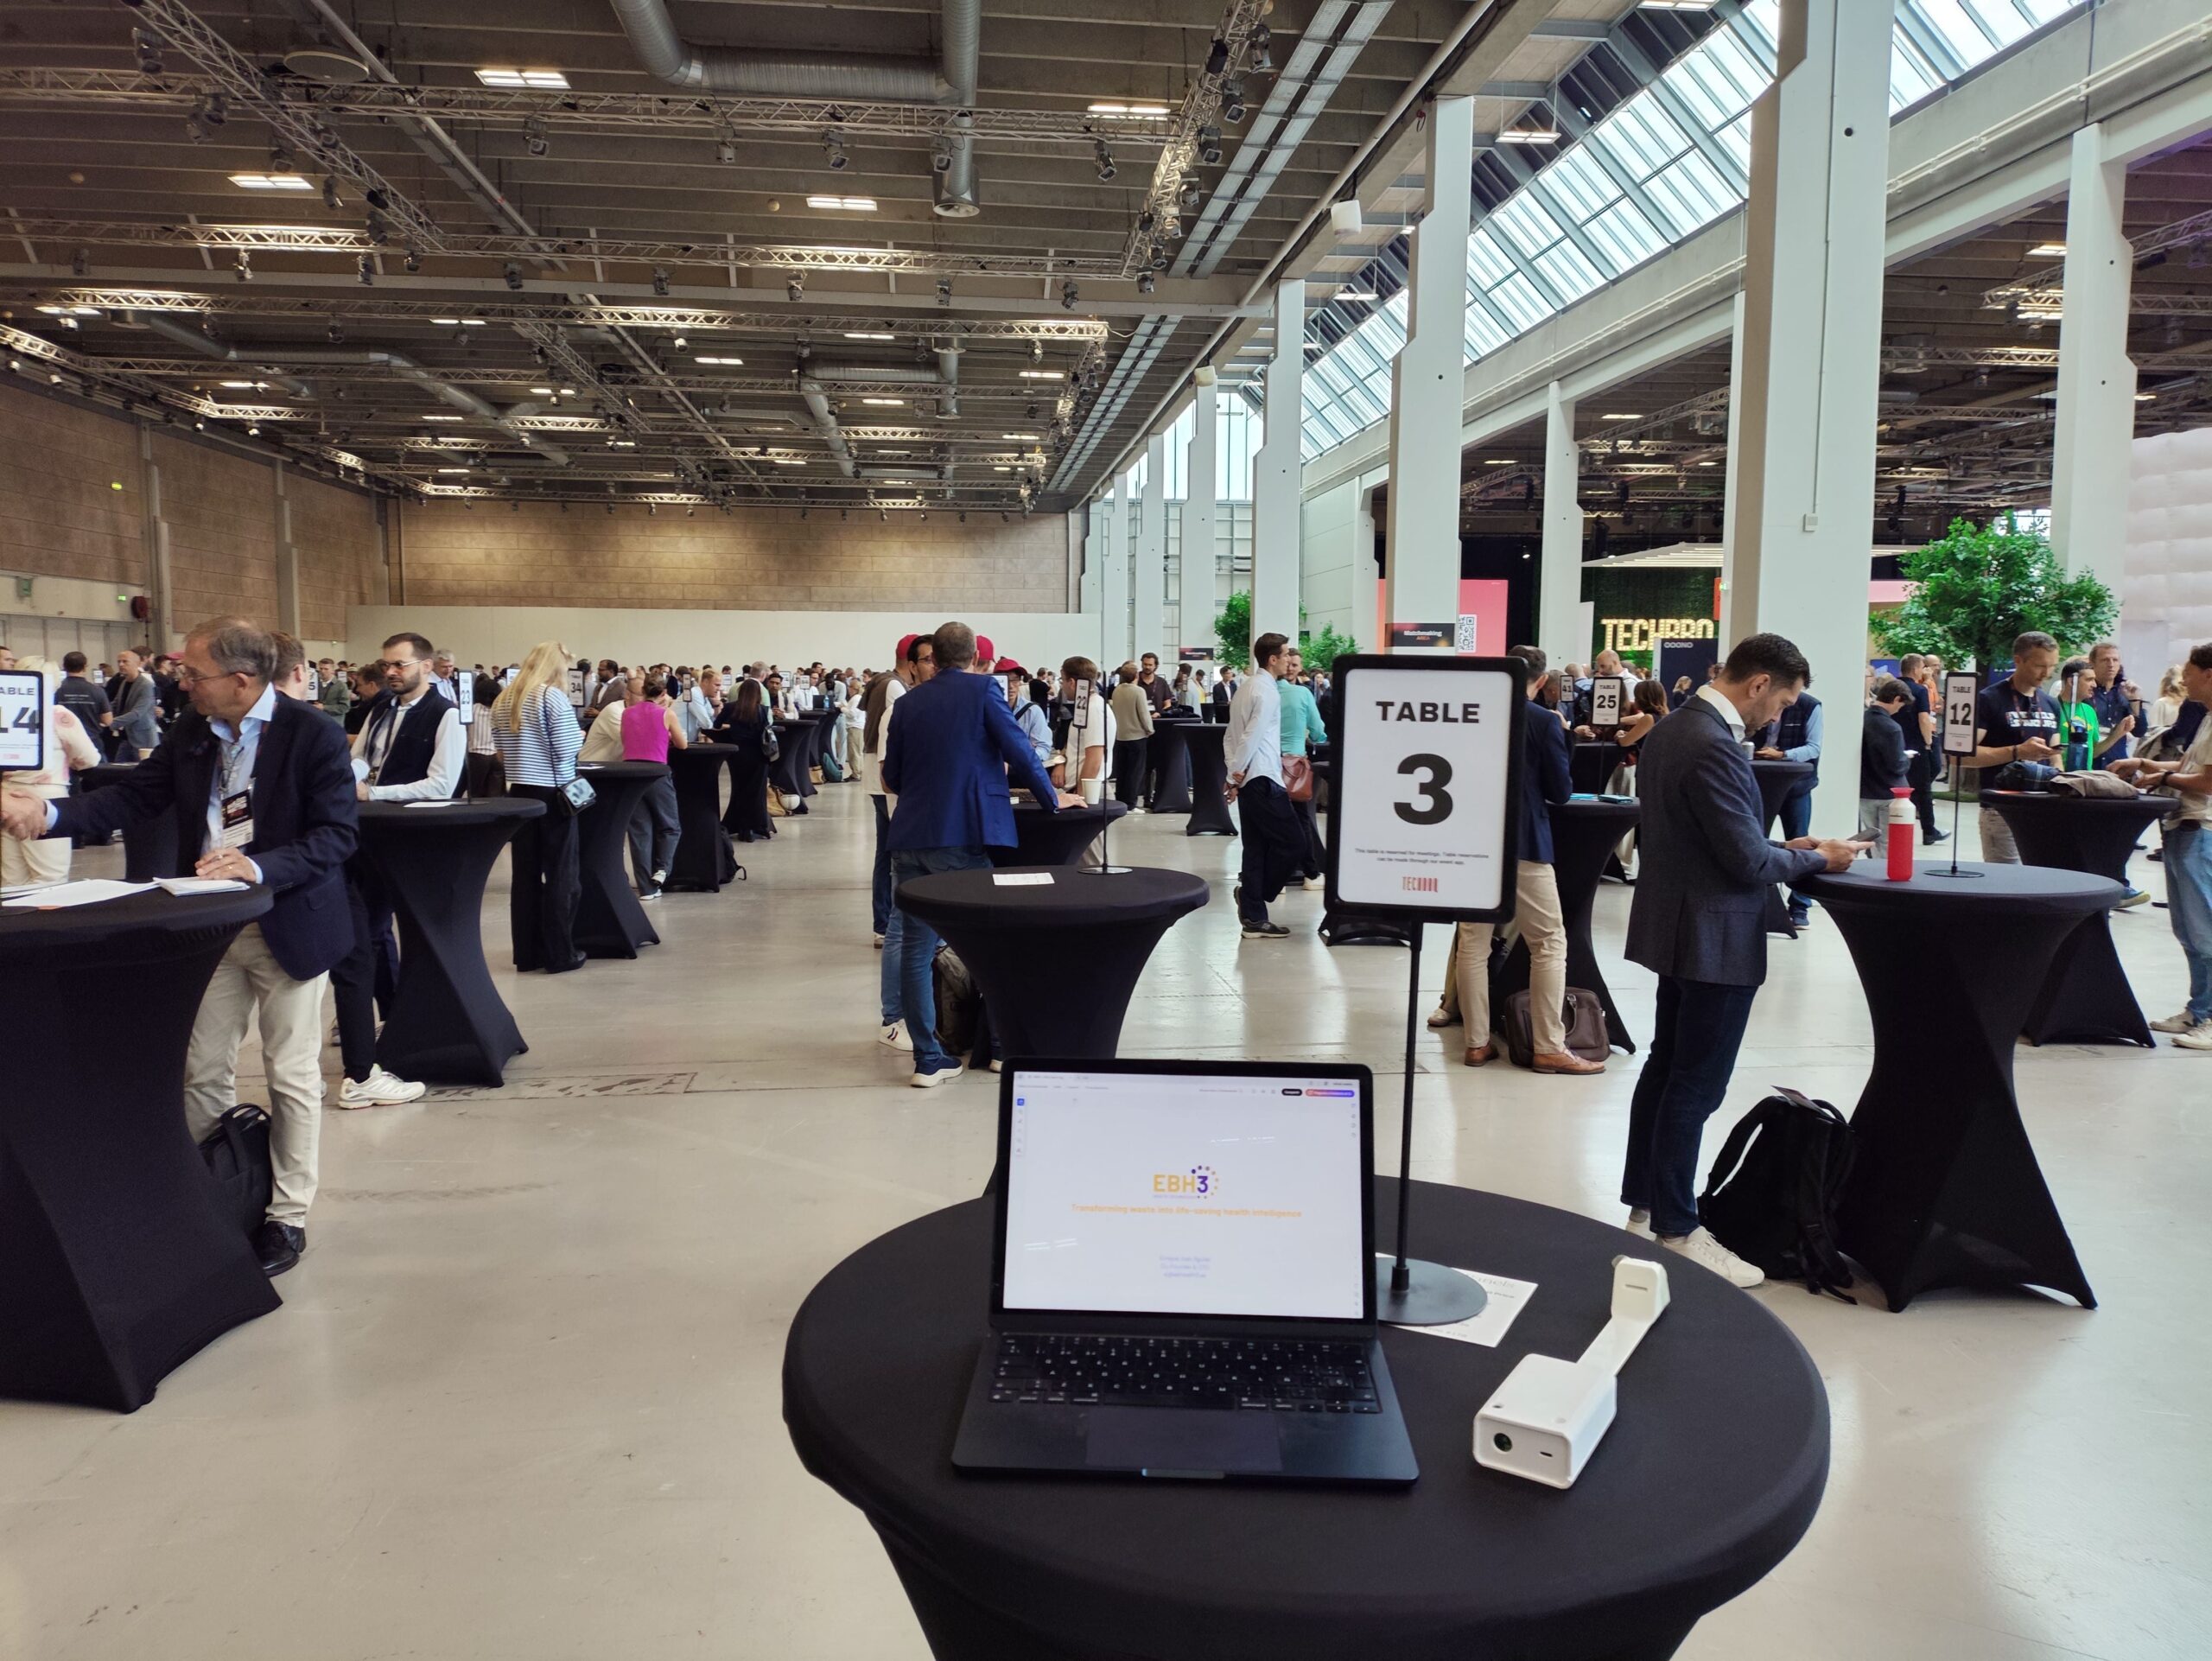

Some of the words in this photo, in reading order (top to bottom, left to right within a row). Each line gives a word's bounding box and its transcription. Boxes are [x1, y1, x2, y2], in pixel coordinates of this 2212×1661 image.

[571, 682, 582, 693] 34
[1077, 696, 1086, 710] 22
[1597, 695, 1617, 709] 25
[1376, 701, 1480, 723] TABLE
[1949, 703, 1972, 725] 12
[1393, 753, 1453, 824] 3
[1154, 1174, 1208, 1193] EBH3
